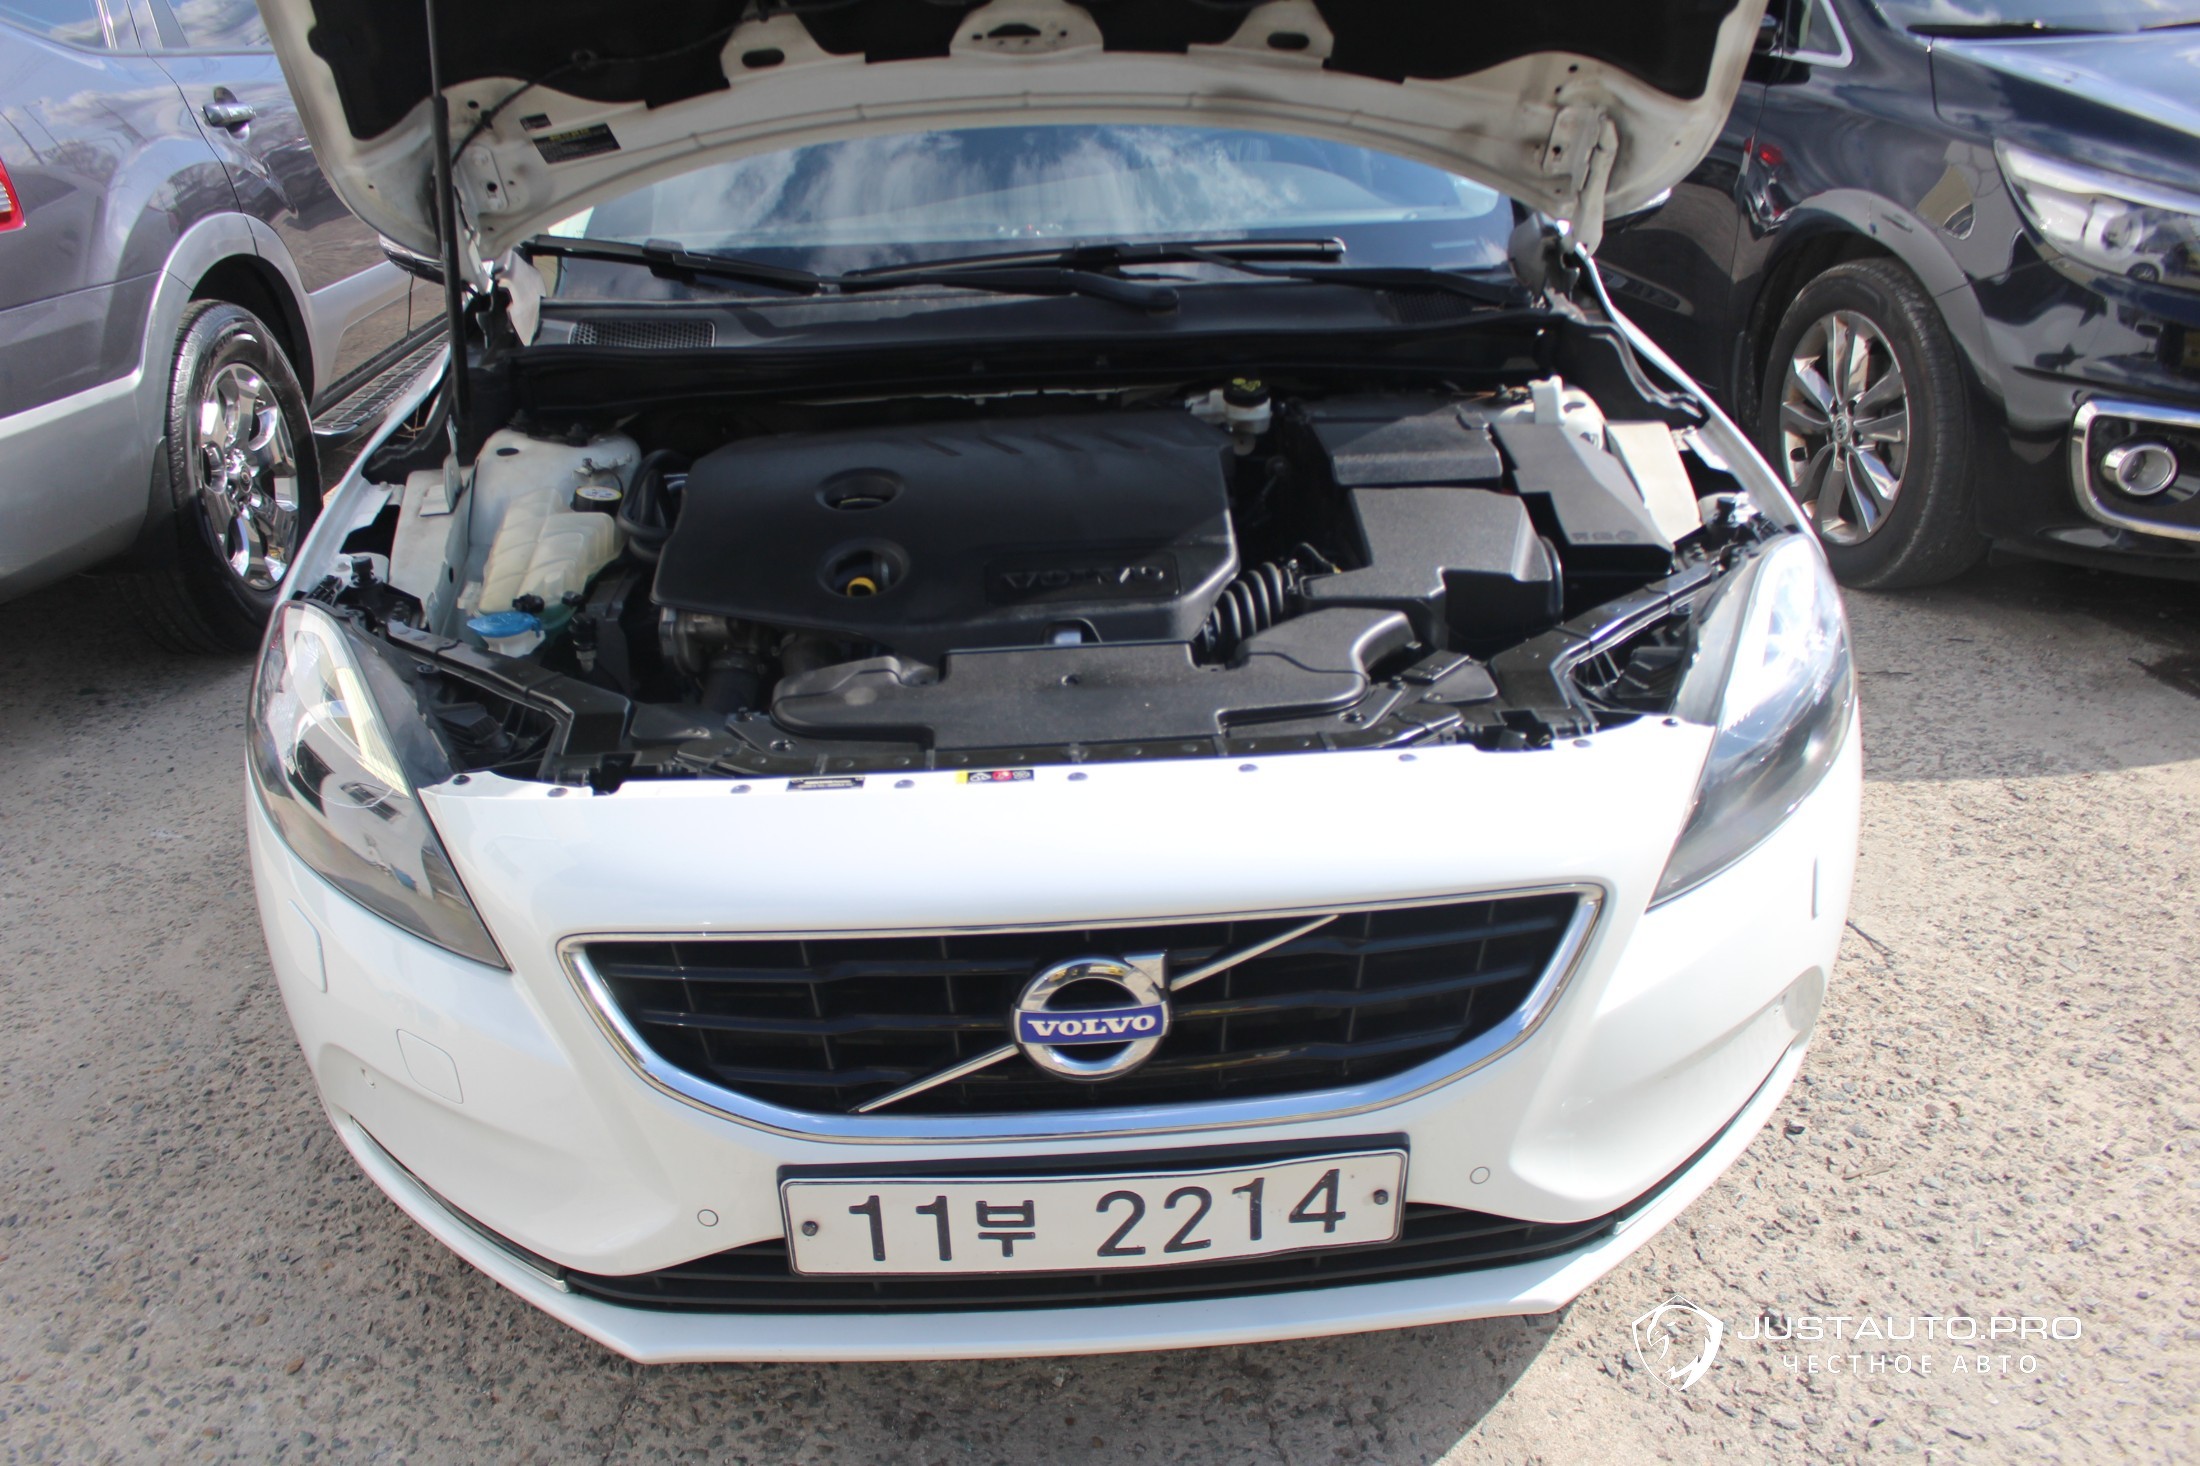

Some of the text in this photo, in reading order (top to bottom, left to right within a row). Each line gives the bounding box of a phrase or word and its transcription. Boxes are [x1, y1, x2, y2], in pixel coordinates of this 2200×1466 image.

[1027, 1014, 1156, 1037] VOLVO
[848, 1168, 1347, 1262] 11부 2214
